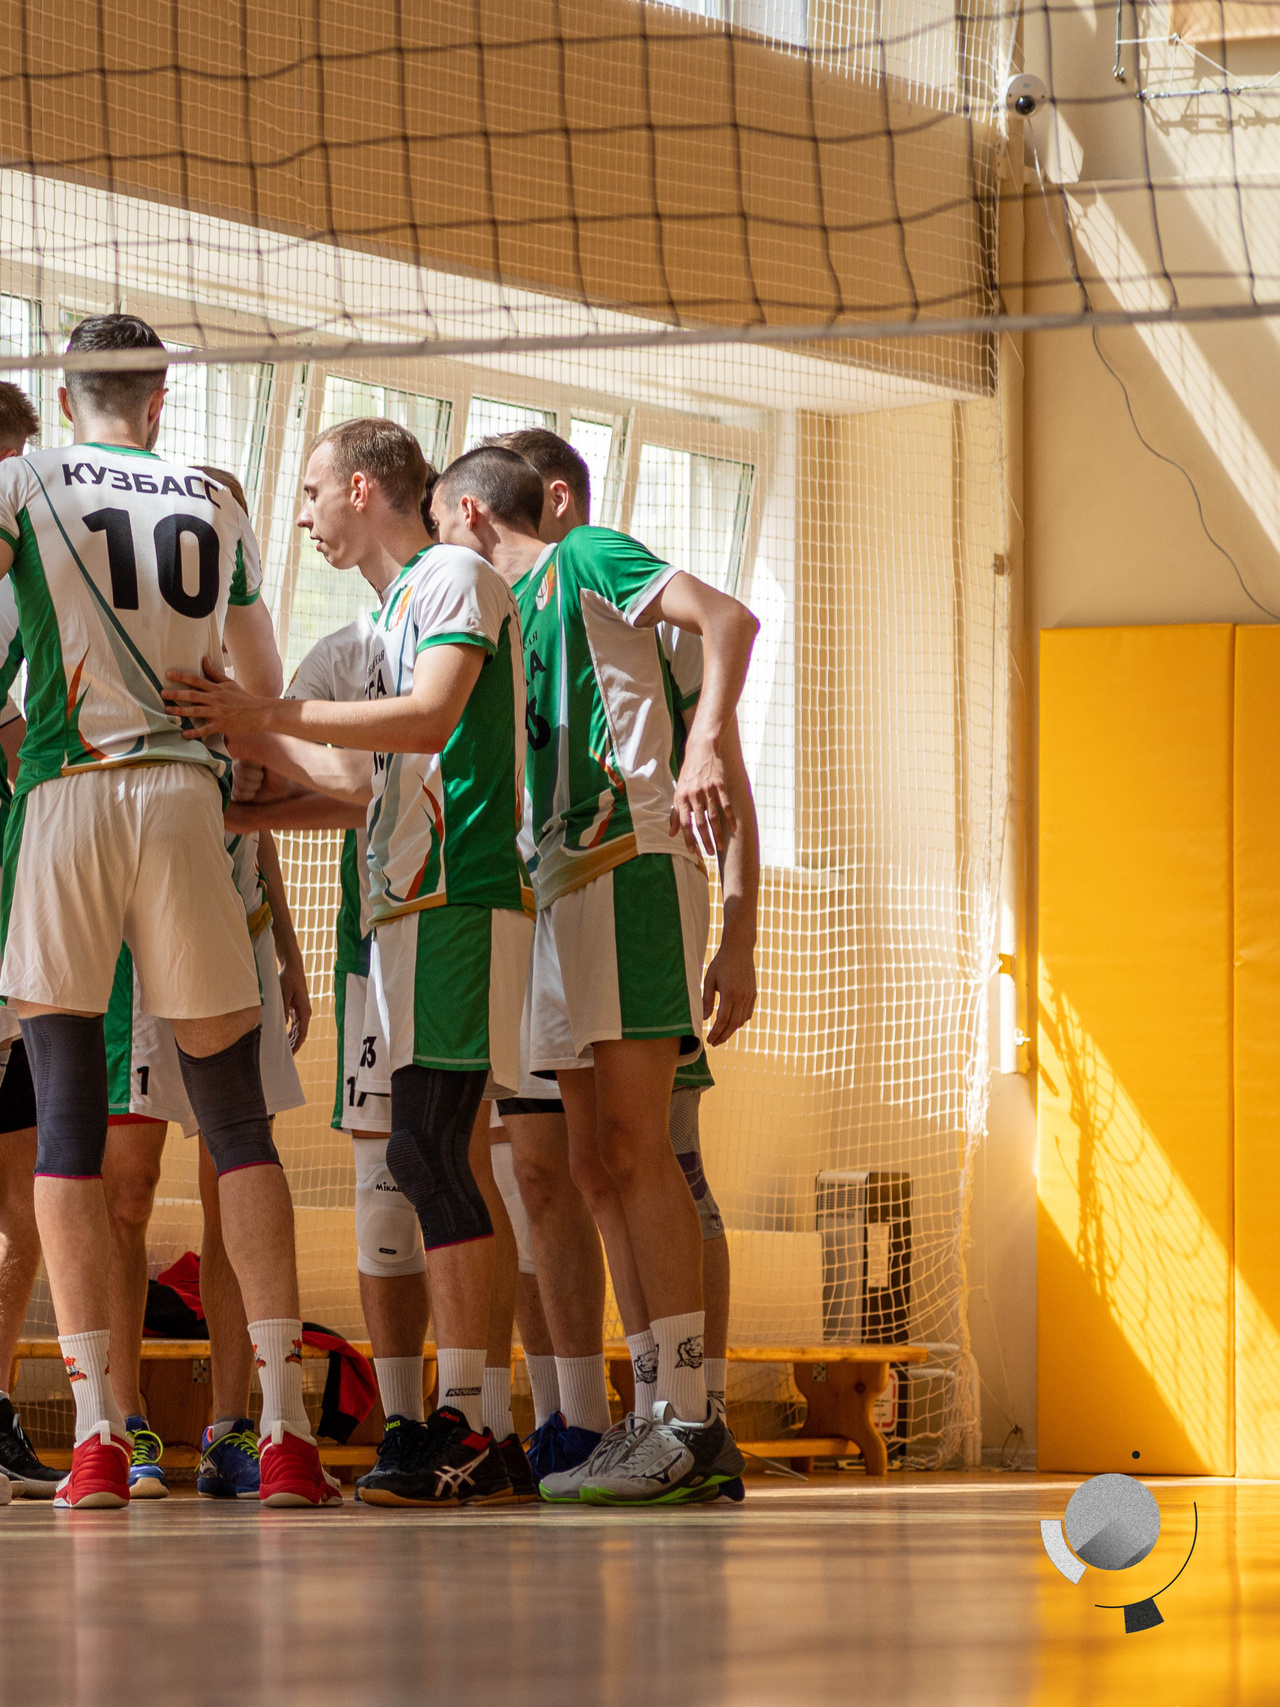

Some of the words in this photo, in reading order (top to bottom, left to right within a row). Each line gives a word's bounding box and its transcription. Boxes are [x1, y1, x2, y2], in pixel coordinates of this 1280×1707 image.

[61, 462, 222, 510] КУЗБАСС
[82, 507, 220, 619] 10
[136, 1065, 150, 1096] 1
